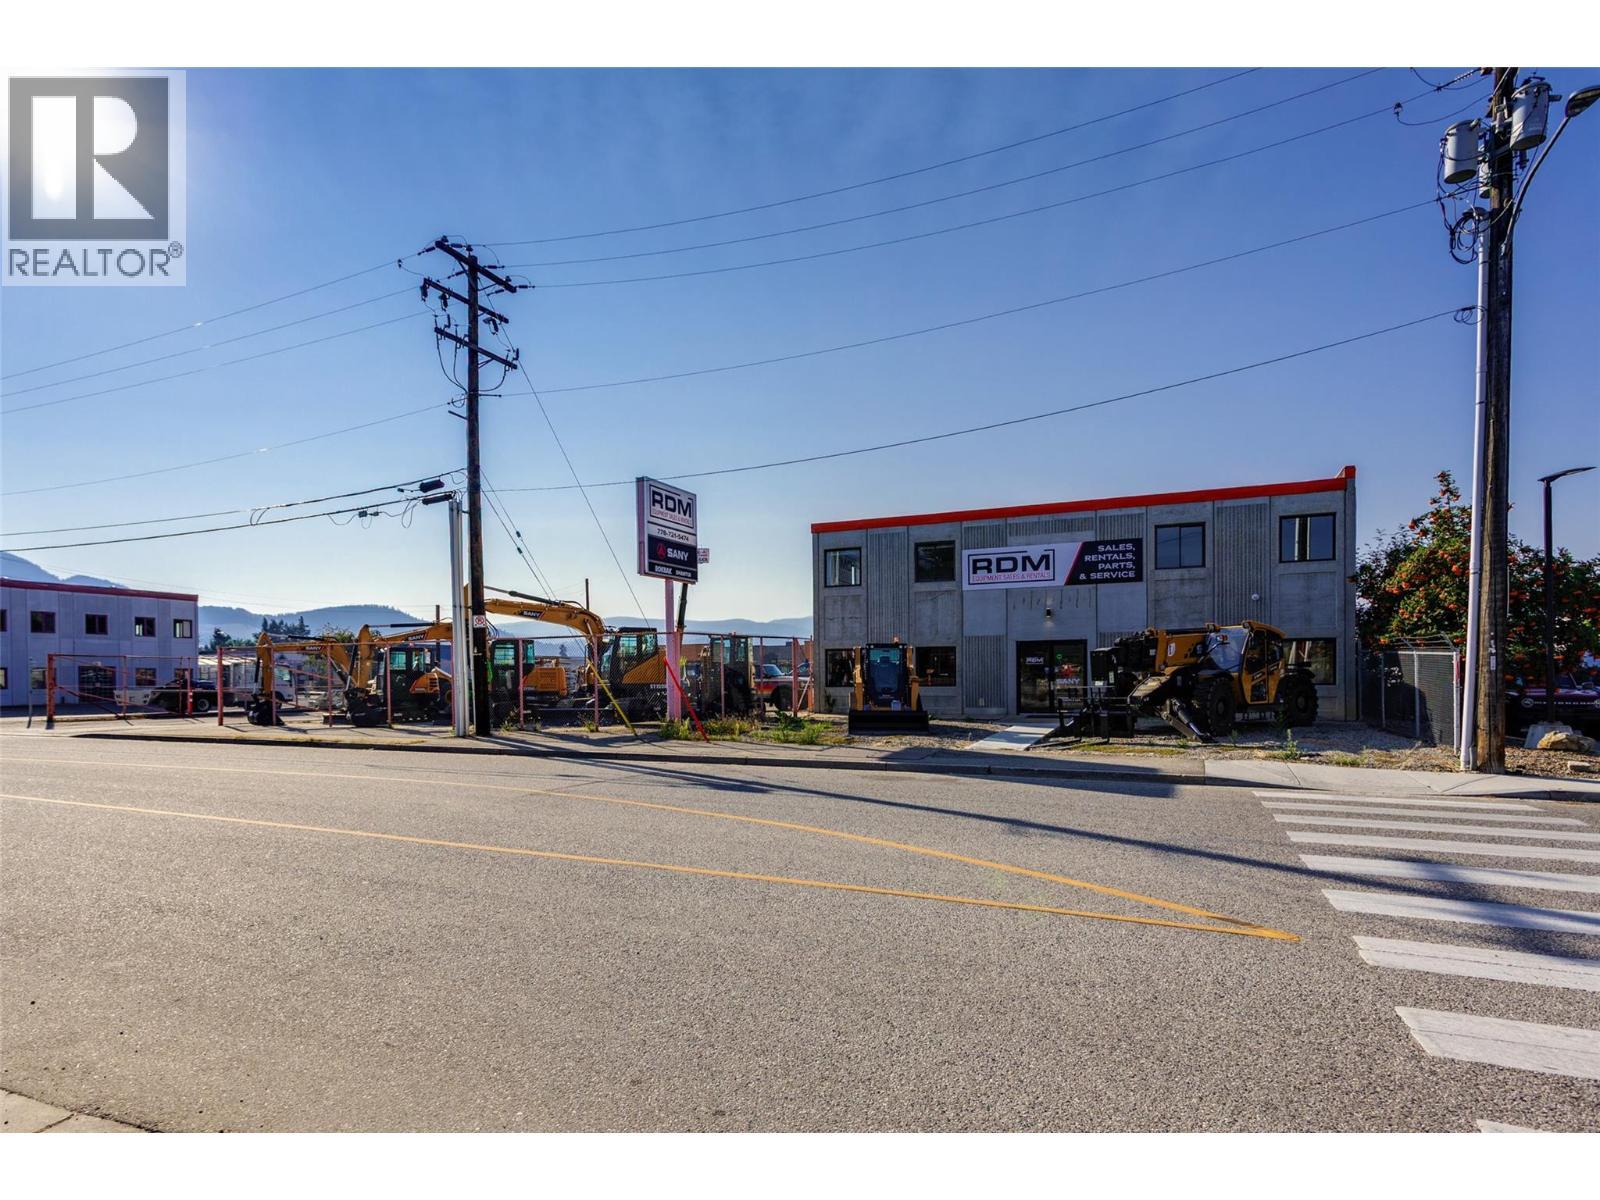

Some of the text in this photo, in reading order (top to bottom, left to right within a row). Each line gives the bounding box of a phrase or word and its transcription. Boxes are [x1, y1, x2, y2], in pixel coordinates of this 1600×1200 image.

[652, 490, 692, 518] RDM
[1097, 543, 1136, 552] SALES,
[667, 548, 689, 561] SANY
[1084, 552, 1136, 562] RENTALS,
[972, 554, 1051, 574] RDM
[1098, 561, 1136, 570] PARTS,
[1090, 570, 1136, 580] SERVICE
